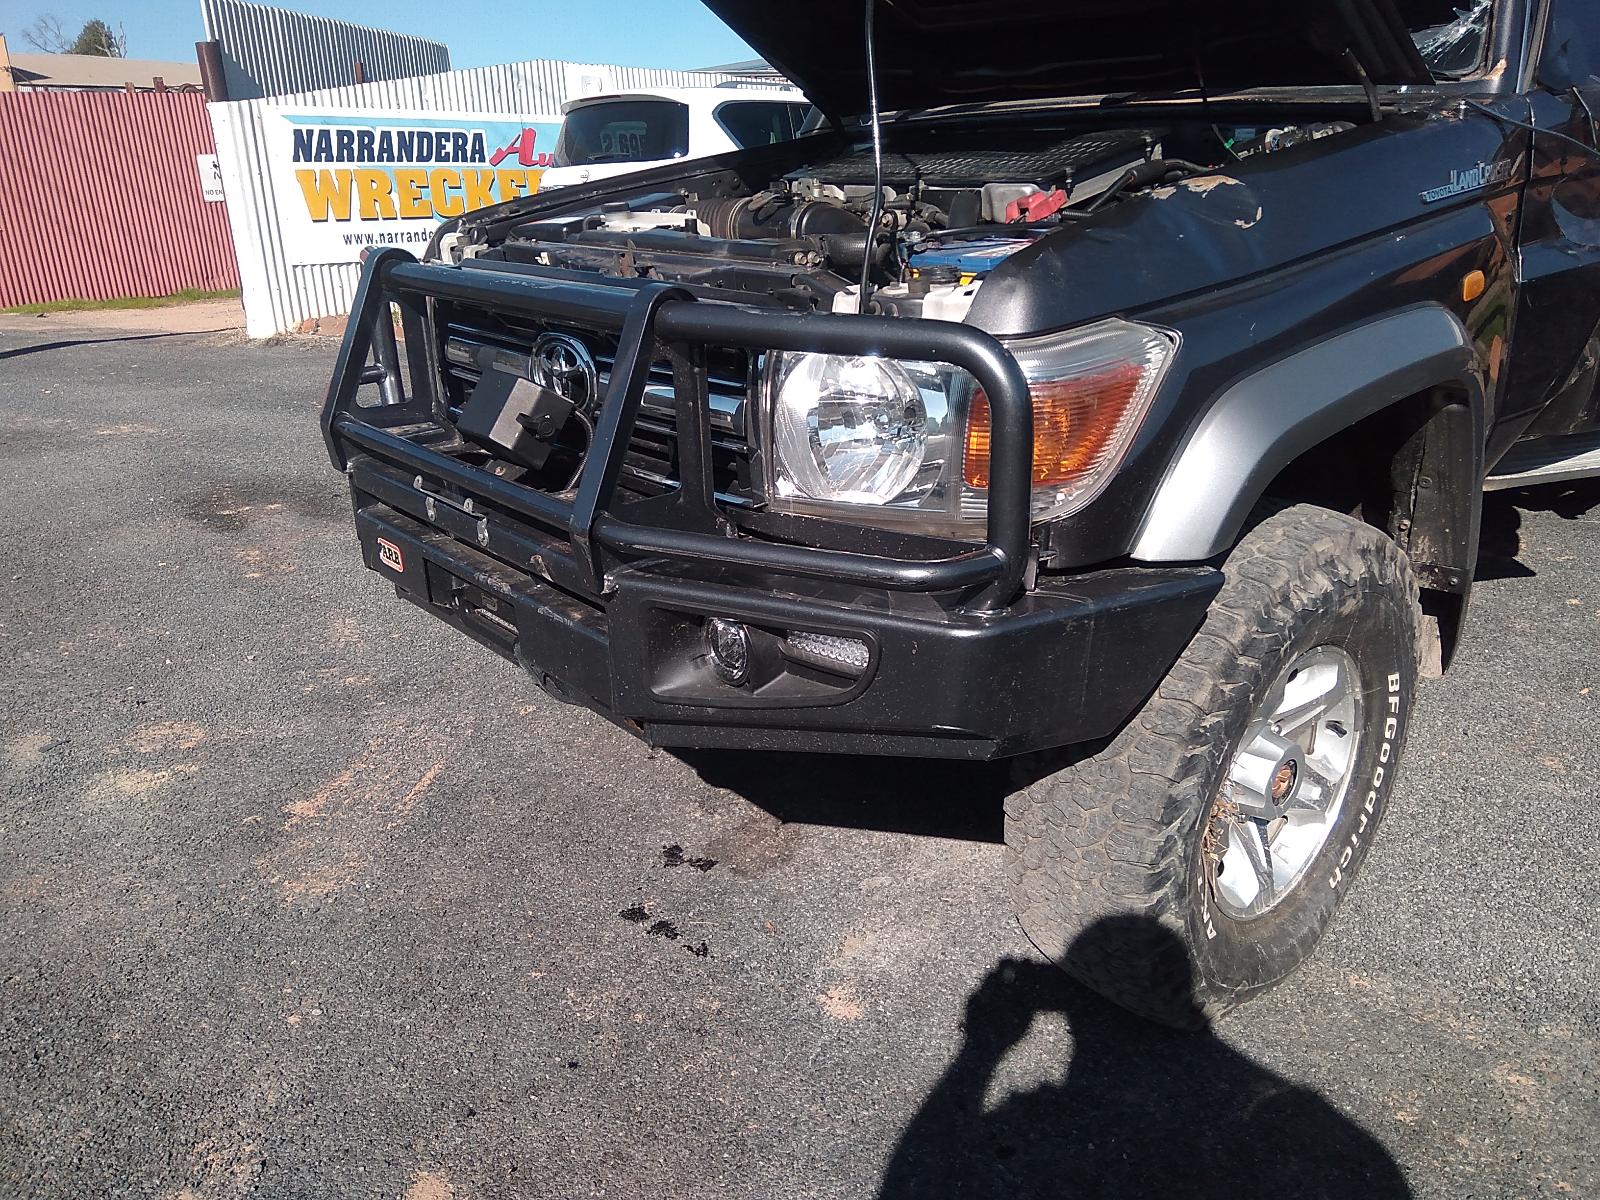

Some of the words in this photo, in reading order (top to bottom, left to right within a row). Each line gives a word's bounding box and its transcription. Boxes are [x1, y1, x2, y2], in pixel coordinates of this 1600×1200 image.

[292, 128, 487, 164] NARRANDERA
[1426, 183, 1453, 202] TOYOTA
[382, 544, 401, 566] ARB
